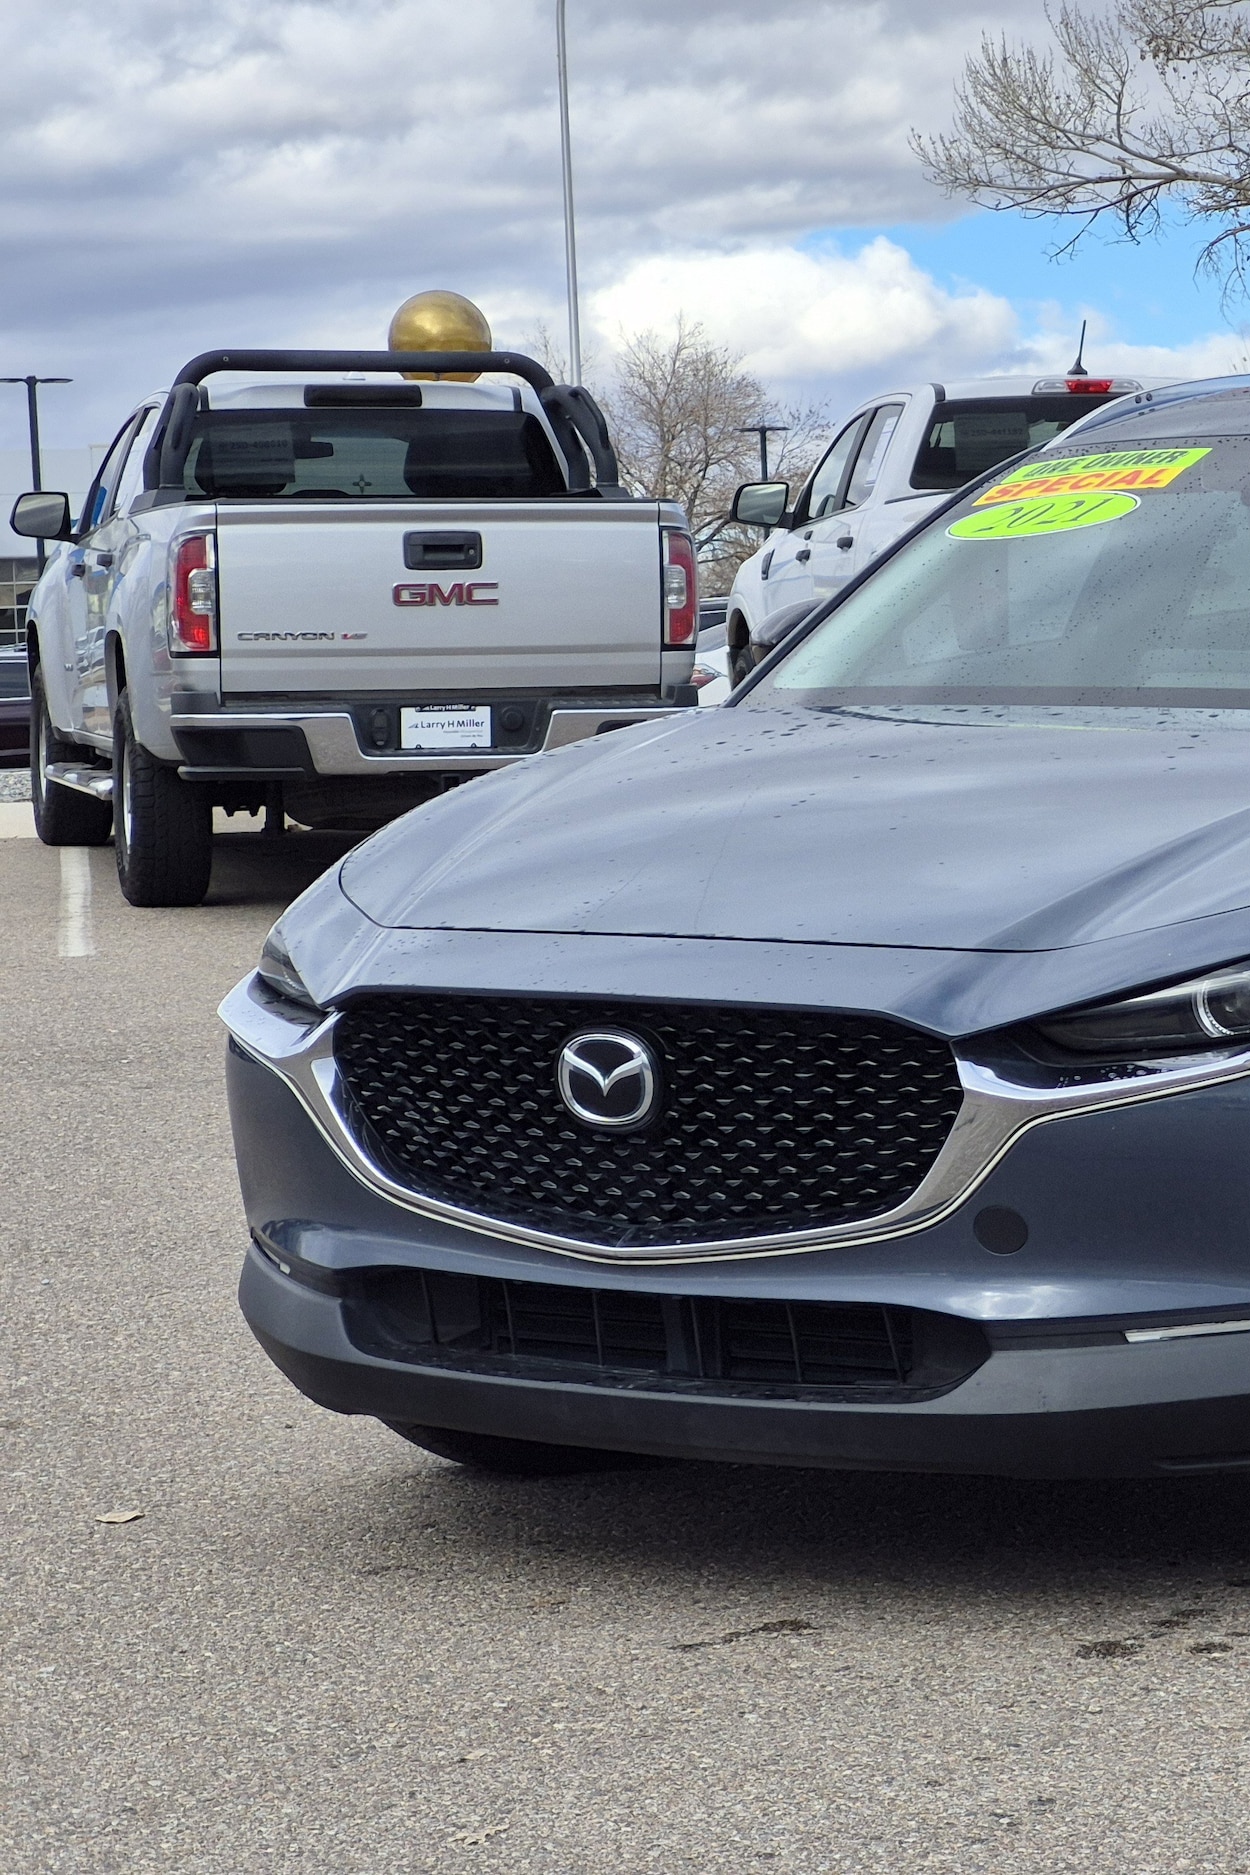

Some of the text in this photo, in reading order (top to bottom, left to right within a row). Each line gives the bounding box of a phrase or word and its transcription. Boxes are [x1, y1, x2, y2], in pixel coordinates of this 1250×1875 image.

[1023, 450, 1189, 478] ONE OWNER
[984, 468, 1170, 501] SPECIAL
[973, 497, 1116, 533] 2021
[392, 581, 499, 607] GMC
[237, 631, 335, 642] CANYON
[421, 719, 485, 729] Larry H Miller
